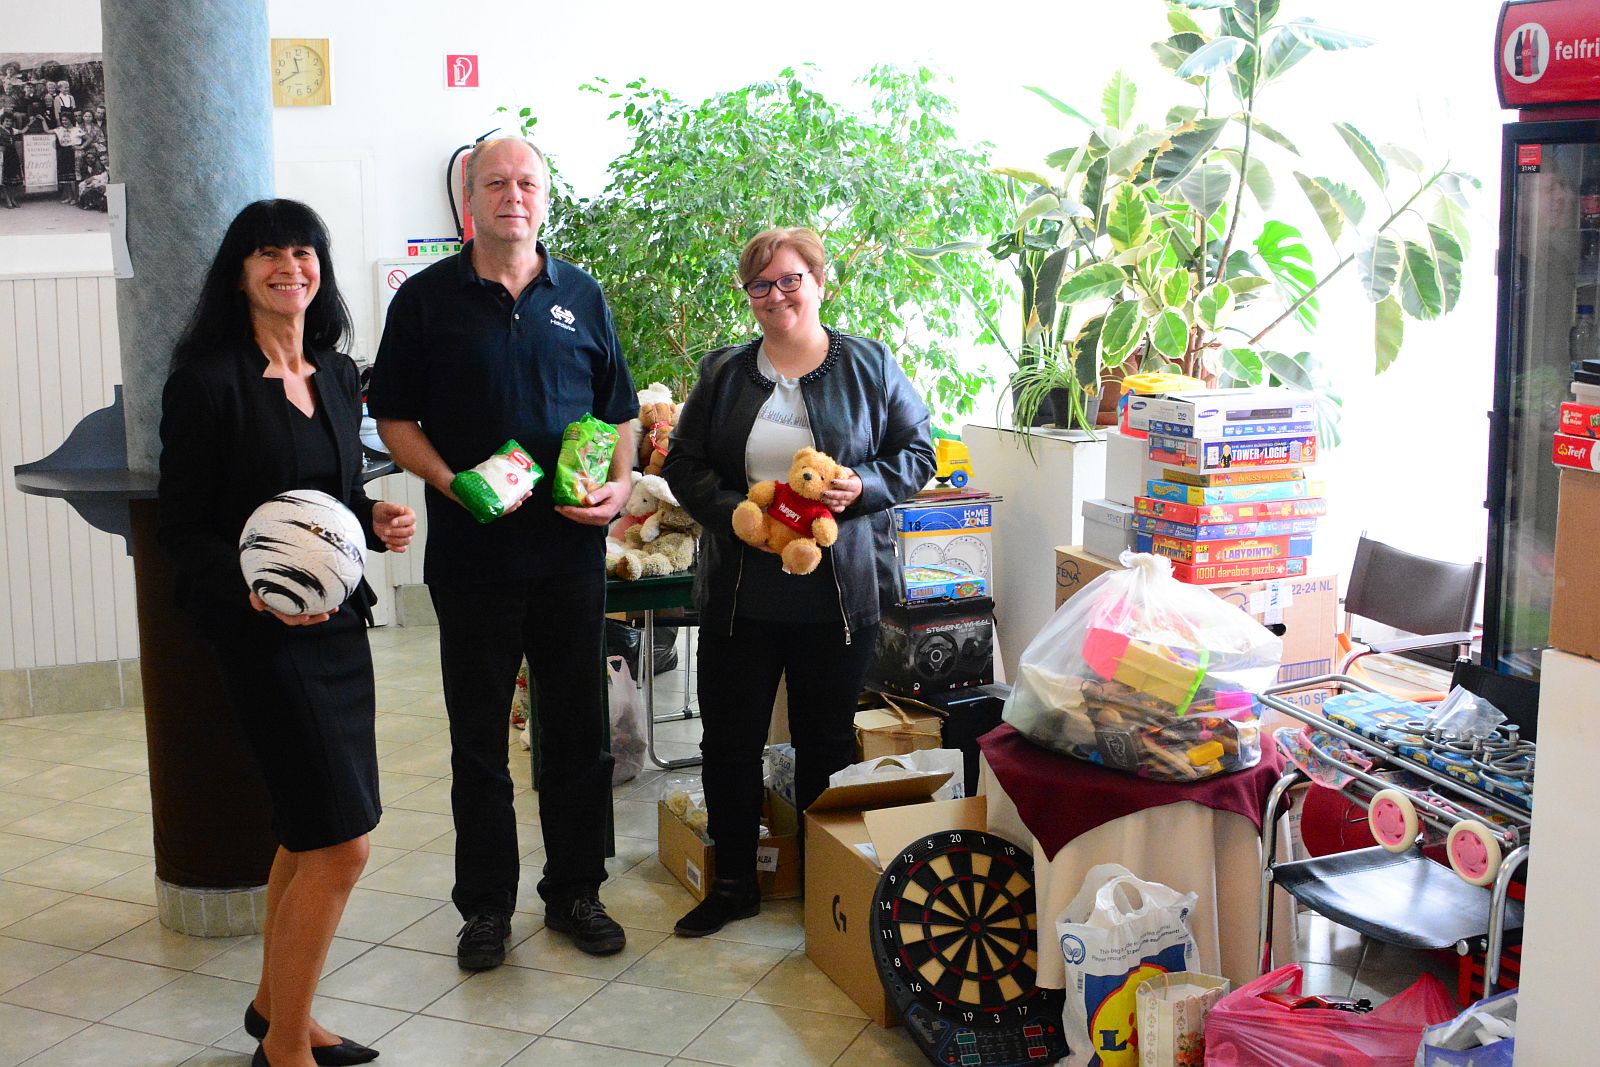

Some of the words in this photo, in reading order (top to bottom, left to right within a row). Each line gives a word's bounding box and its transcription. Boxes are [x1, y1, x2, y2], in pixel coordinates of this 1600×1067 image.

[1232, 448, 1260, 460] TOWER
[1264, 446, 1287, 459] LOGIC
[1568, 446, 1586, 460] Trefl
[778, 502, 801, 522] Hungary
[964, 508, 988, 518] HOME
[1294, 500, 1326, 516] 1000
[908, 520, 922, 531] 18
[964, 518, 988, 526] ZONE
[1224, 547, 1272, 560] LABYRINTH
[1056, 566, 1080, 584] TENA
[1196, 567, 1216, 580] 1000
[1218, 566, 1250, 578] darabos
[1252, 563, 1275, 578] puzzle
[1320, 580, 1333, 592] NL
[926, 624, 962, 634] STEERING
[964, 618, 990, 628] WHEEL
[950, 834, 962, 843] 20
[1004, 847, 1016, 856] 18
[903, 854, 914, 863] 12
[880, 901, 891, 910] 14
[883, 929, 893, 938] 11
[910, 983, 922, 993] 16
[1018, 1006, 1028, 1016] 17
[962, 1012, 974, 1022] 19
